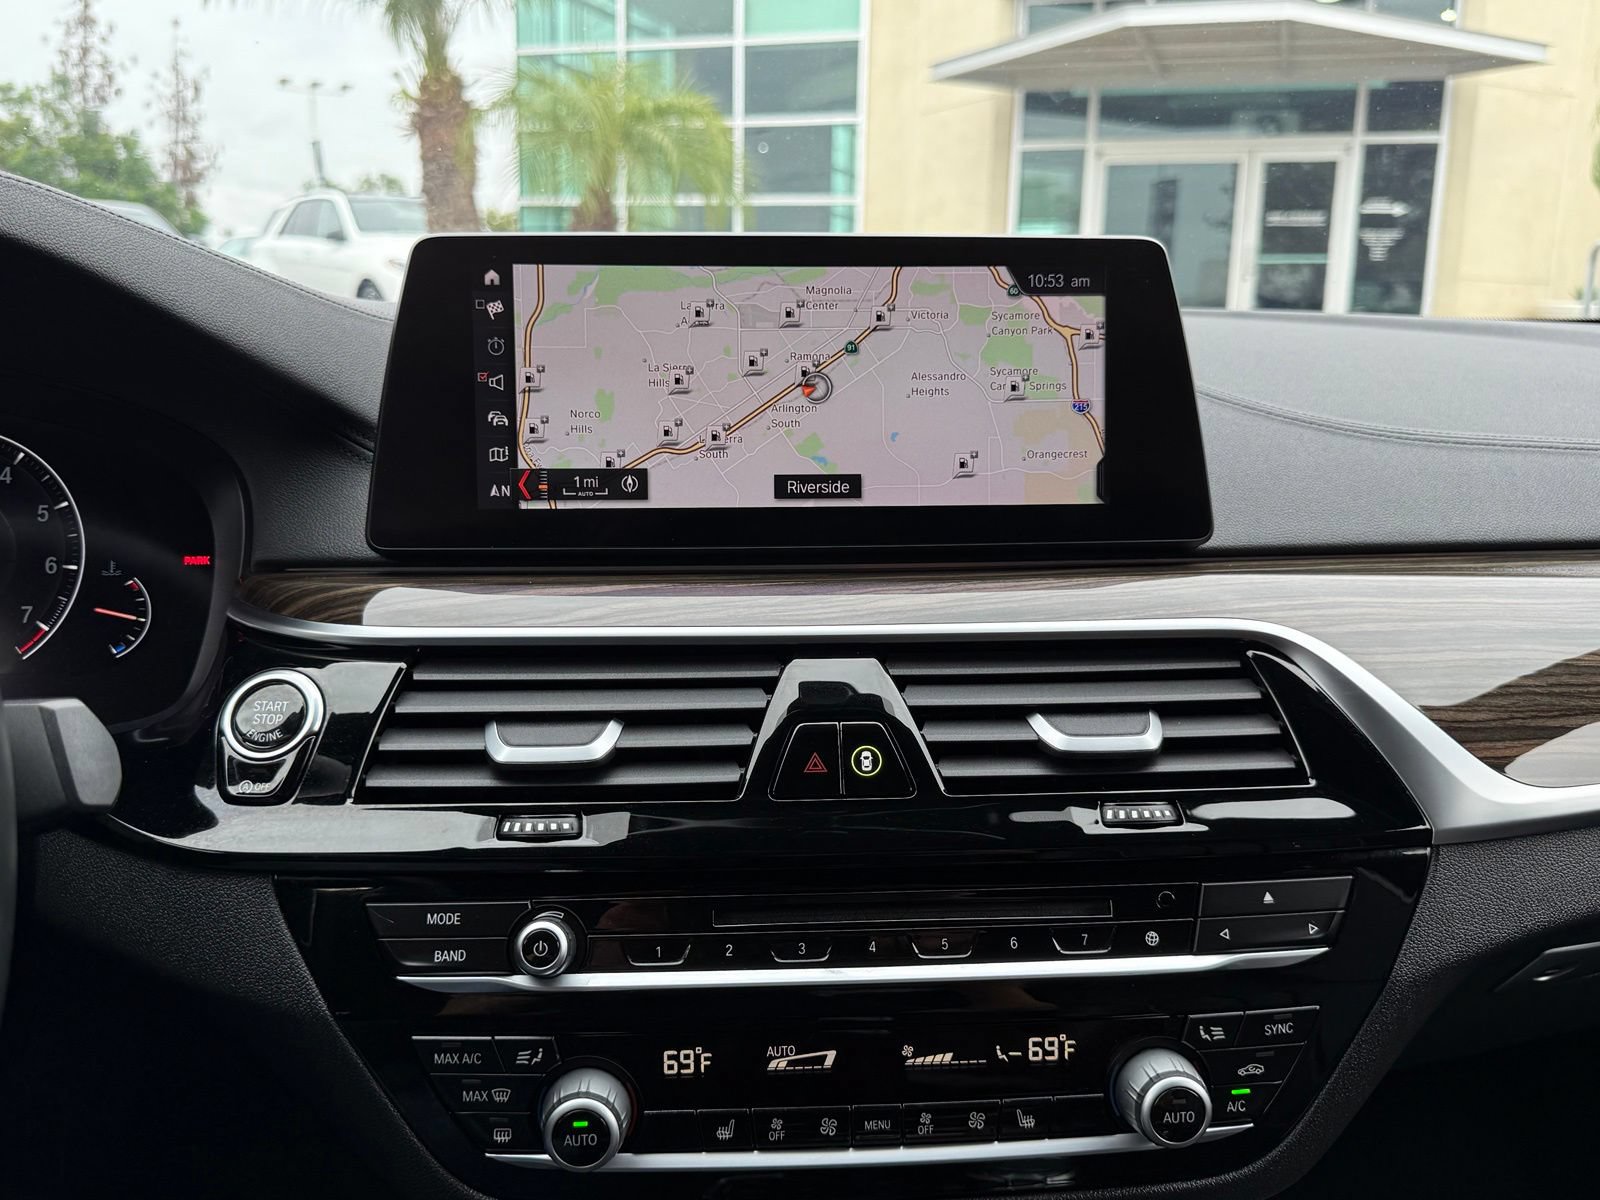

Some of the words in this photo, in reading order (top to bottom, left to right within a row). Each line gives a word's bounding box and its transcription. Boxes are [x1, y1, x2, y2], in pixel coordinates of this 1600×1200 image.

[1027, 273, 1065, 288] 10:53
[1070, 277, 1091, 288] am
[805, 284, 853, 297] Magnolia
[680, 300, 691, 311] La
[805, 300, 839, 311] Center
[910, 310, 950, 321] Victoria
[991, 311, 1041, 324] Sycamore
[991, 325, 1029, 339] Canyon
[1031, 325, 1054, 336] Park
[846, 343, 856, 353] 91
[790, 352, 831, 363] Ramona
[648, 363, 660, 373] La
[990, 367, 1039, 380] Sycamore
[911, 370, 967, 382] Alessandro
[648, 378, 670, 388] Hills
[1029, 381, 1067, 395] Springs
[911, 385, 950, 398] Heights
[771, 402, 817, 415] Arlington
[1073, 402, 1088, 411] 215
[570, 408, 601, 419] Norco
[570, 423, 593, 435] Hills
[771, 417, 800, 428] South
[699, 449, 729, 459] South
[1026, 448, 1088, 462] Orangecrest
[0, 466, 12, 484] 4
[573, 476, 580, 488] 1
[582, 476, 599, 488] mi
[787, 479, 850, 494] Riverside
[501, 485, 511, 497] N
[37, 504, 49, 522] 5
[45, 557, 57, 574] 6
[183, 555, 211, 566] PARK
[21, 605, 33, 624] 7
[252, 700, 289, 713] START
[252, 713, 284, 726] STOP
[245, 728, 284, 743] ENGINE
[254, 782, 272, 791] OFF
[427, 912, 462, 926] MODE
[940, 938, 949, 951] 5
[1009, 936, 1019, 950] 6
[1080, 933, 1089, 947] 7
[655, 945, 662, 959] 1
[725, 944, 734, 957] 2
[797, 942, 807, 956] 3
[868, 940, 877, 954] 4
[433, 949, 467, 963] BAND
[1264, 1022, 1294, 1037] SYNC
[766, 1045, 796, 1058] AUTO
[433, 1052, 460, 1066] MAX
[462, 1051, 482, 1065] A/C
[461, 1089, 489, 1103] MAX
[1226, 1099, 1247, 1114] A/C
[1163, 1110, 1196, 1125] AUTO
[864, 1119, 892, 1132] MENU
[917, 1124, 935, 1136] OFF
[563, 1133, 598, 1148] AUTO
[768, 1130, 786, 1142] OFF
